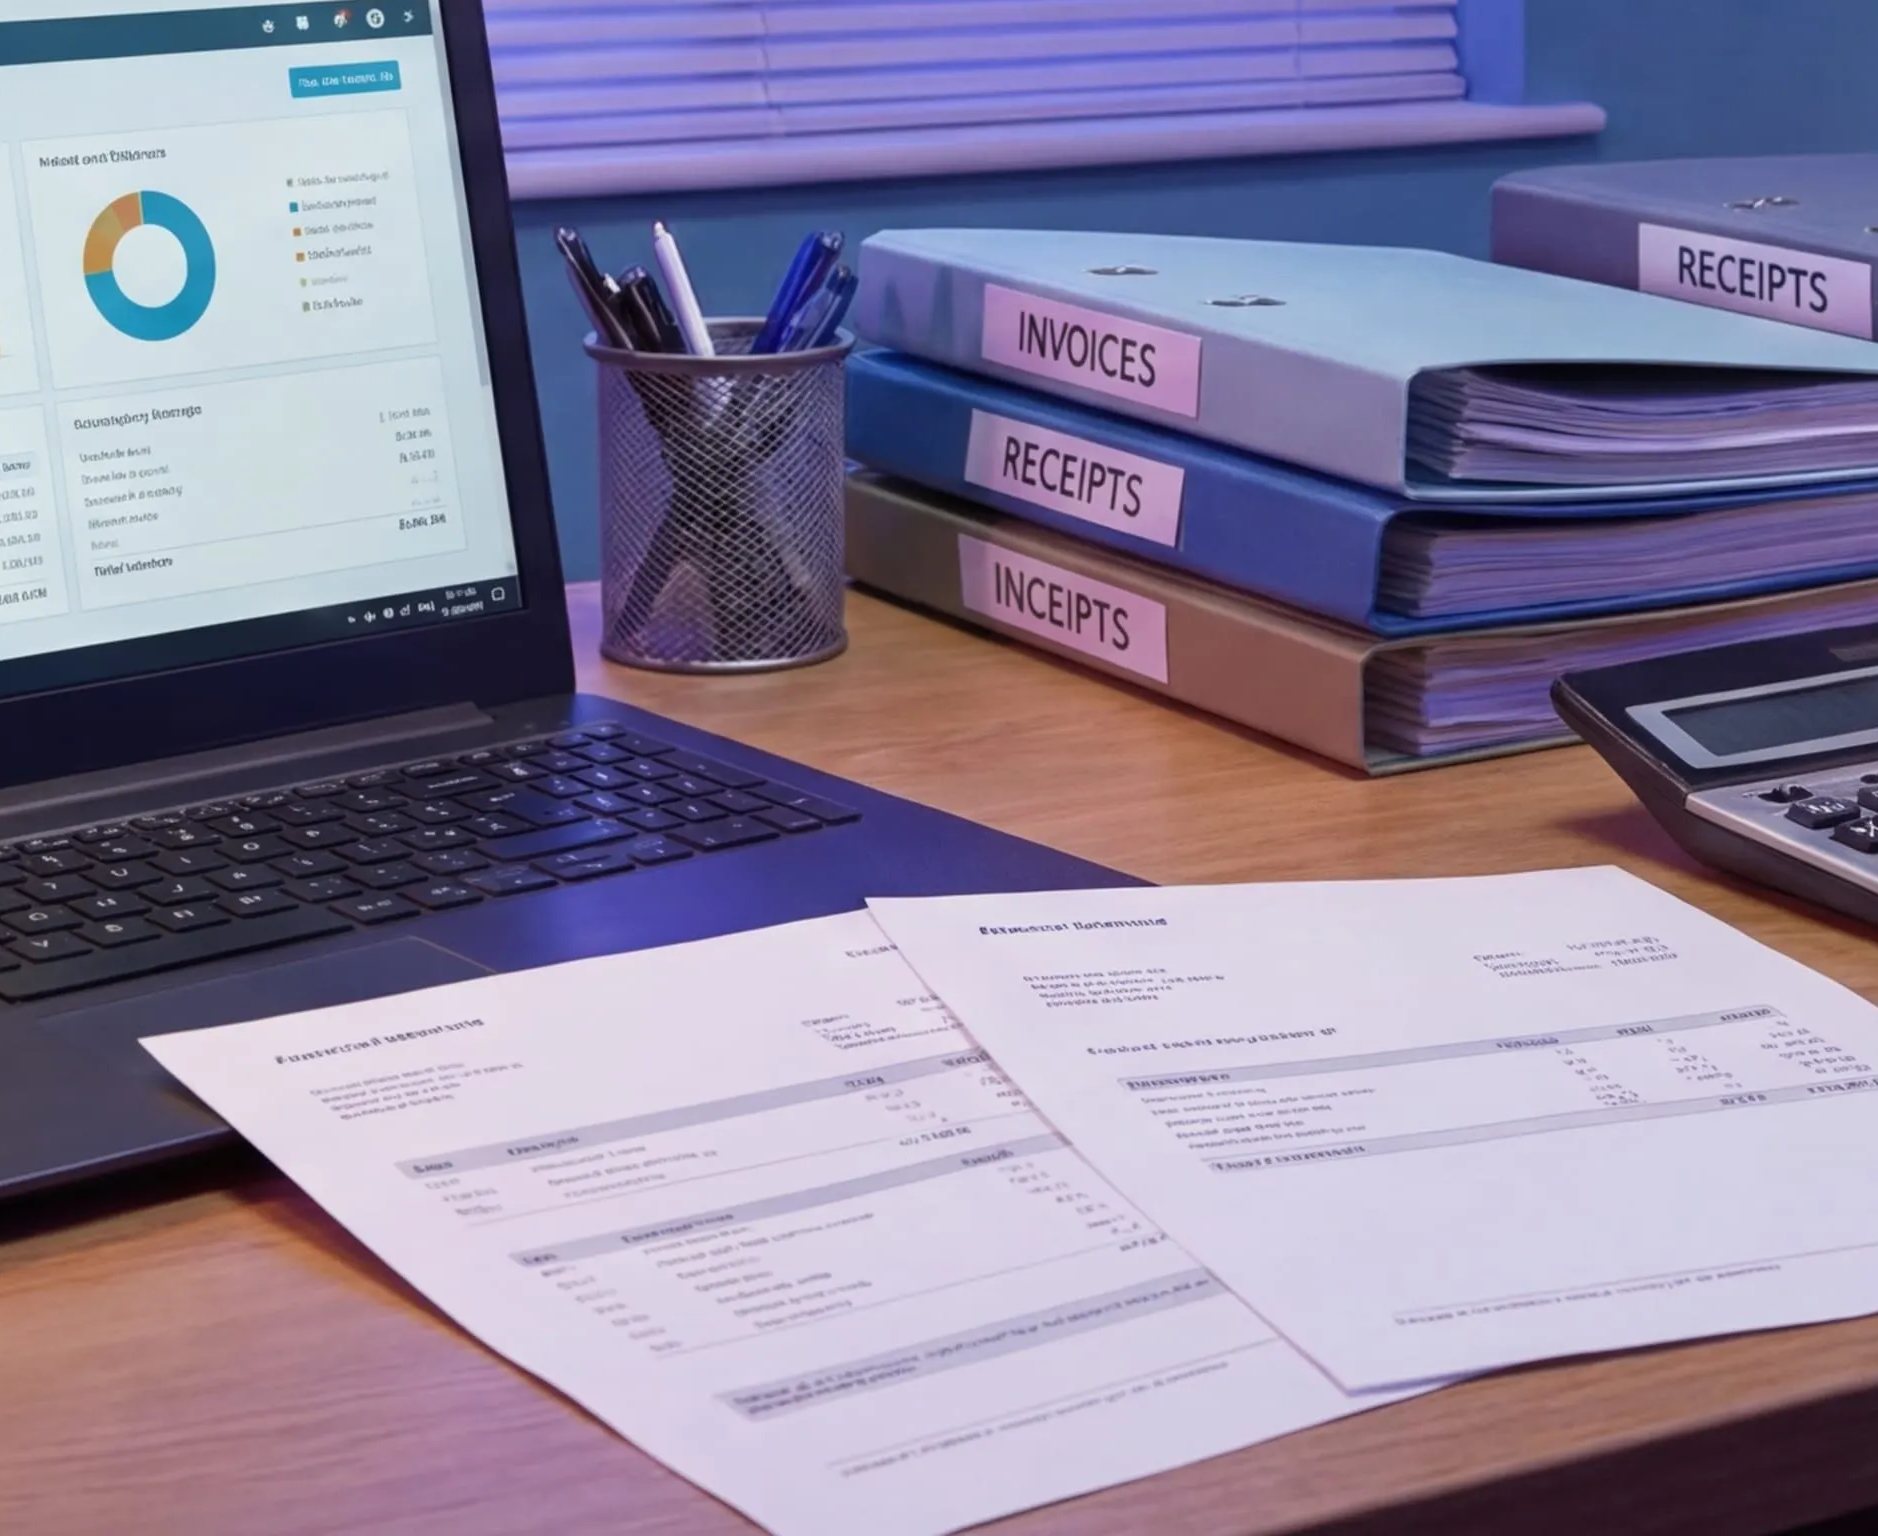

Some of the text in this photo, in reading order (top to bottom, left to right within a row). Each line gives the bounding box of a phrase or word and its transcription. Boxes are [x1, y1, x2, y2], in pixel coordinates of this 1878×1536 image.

[1678, 245, 1829, 314] RECEIPTS
[1017, 310, 1157, 388] INVOICES
[1002, 435, 1143, 518] RECEIPTS
[993, 561, 1131, 652] INCEIPTS
